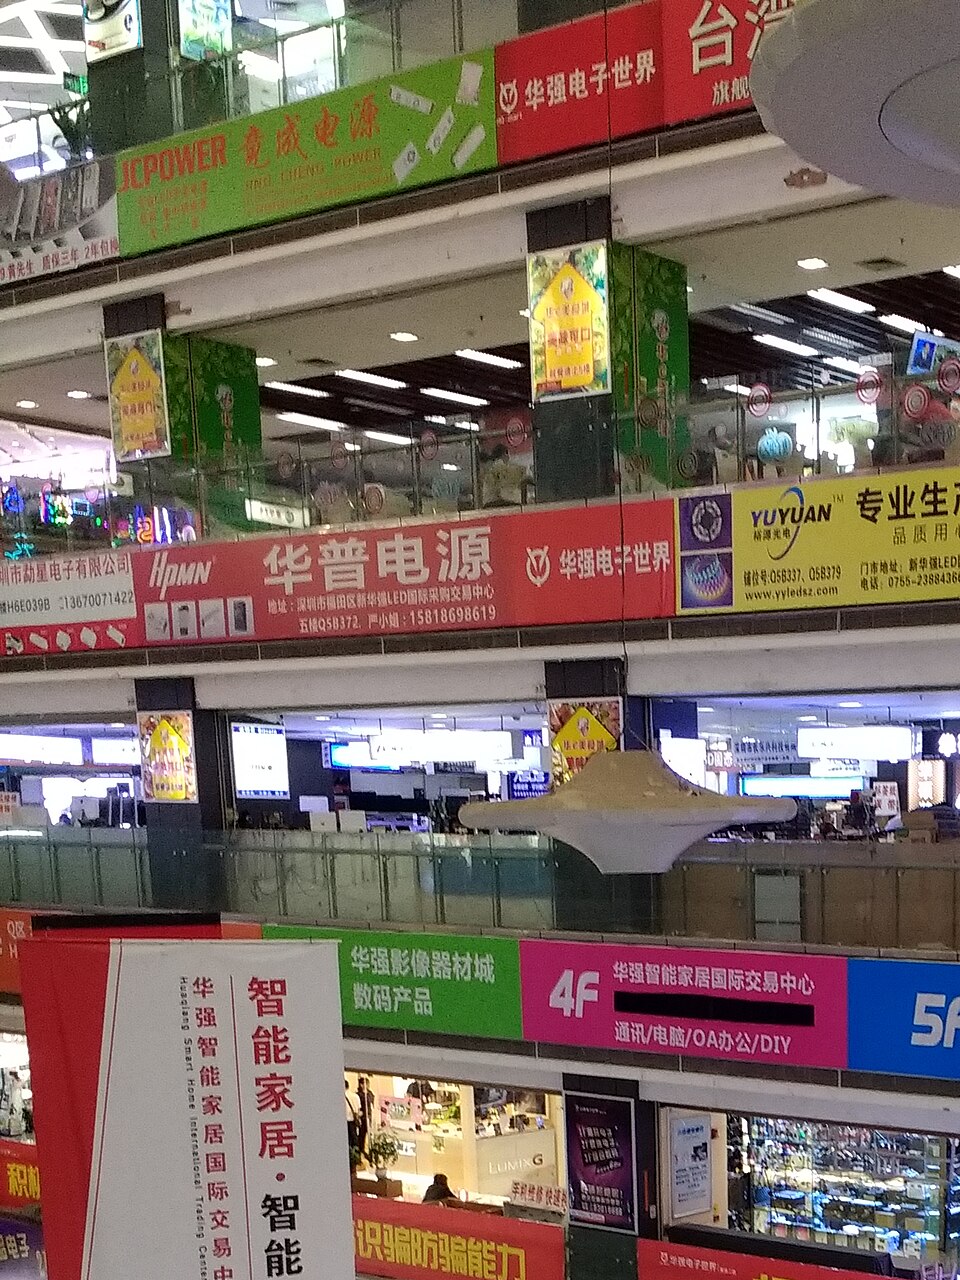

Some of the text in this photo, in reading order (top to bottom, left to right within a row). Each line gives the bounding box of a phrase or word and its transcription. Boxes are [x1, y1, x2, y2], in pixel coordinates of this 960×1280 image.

[525, 49, 655, 111] 华强电子世界
[119, 133, 227, 193] JCPOWER
[751, 504, 832, 527] YUYUAN
[263, 526, 495, 597] 华普电源
[560, 540, 671, 581] 华强电子世界
[351, 945, 496, 985] 华强影像器材城
[353, 982, 433, 1018] 数码产品
[549, 960, 816, 1018] 4F 华强智能家居国际交易中心
[614, 1021, 792, 1055] 通讯/电脑/OA办公/DIY
